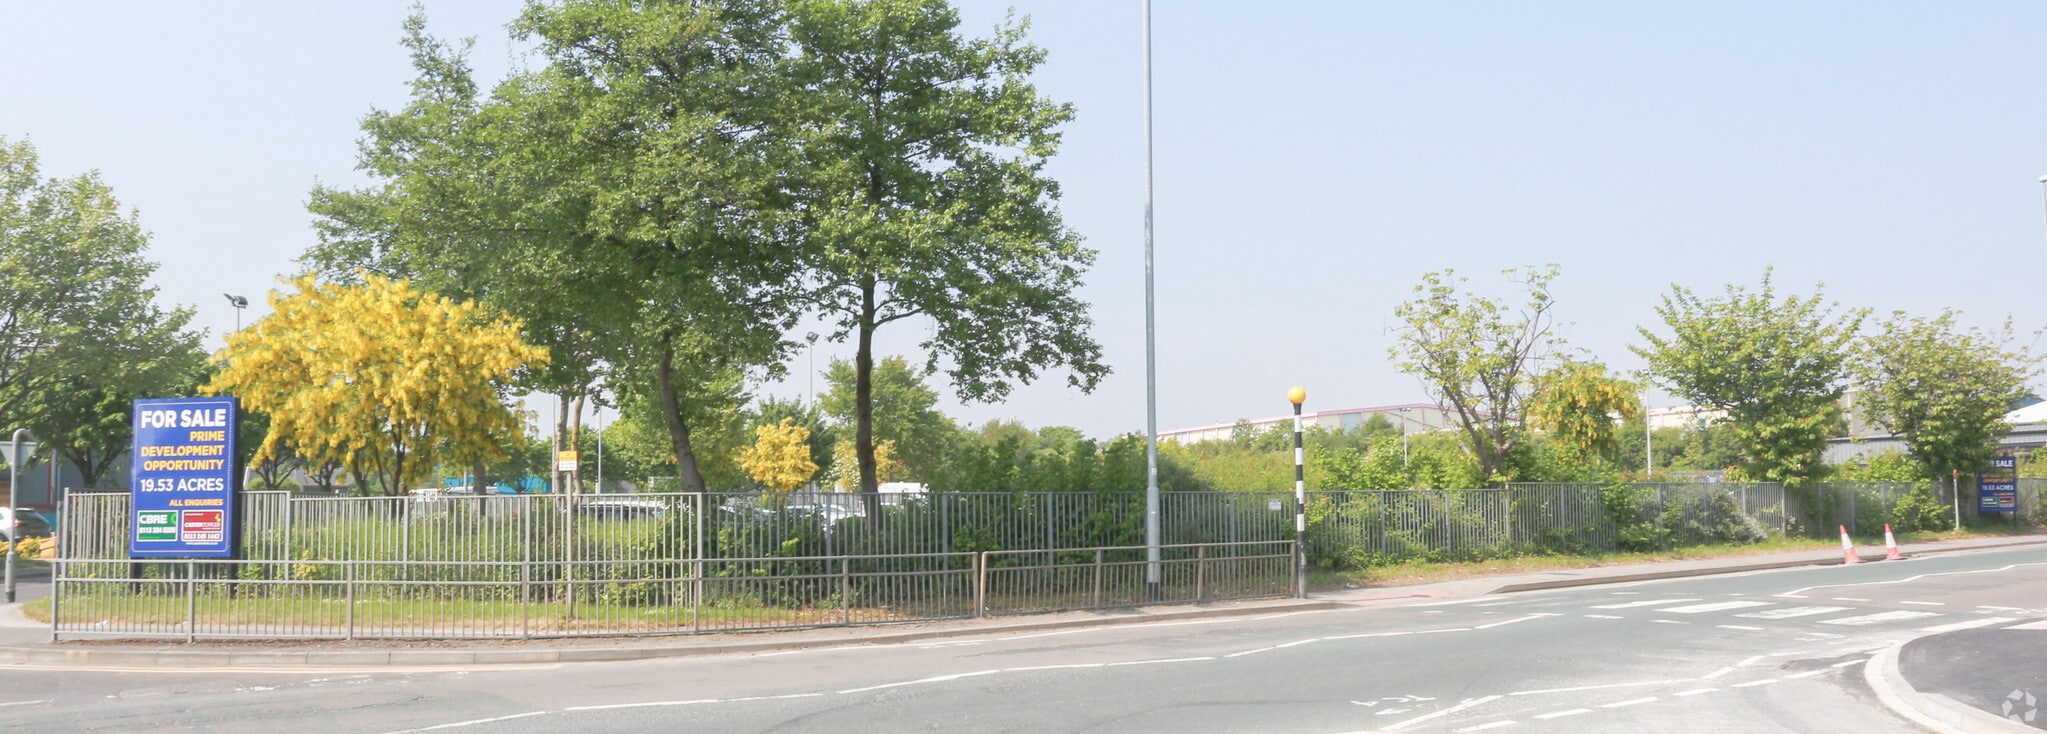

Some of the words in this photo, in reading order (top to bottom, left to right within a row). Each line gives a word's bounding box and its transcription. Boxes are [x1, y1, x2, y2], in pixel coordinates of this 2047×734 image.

[141, 410, 177, 428] FOR
[180, 408, 226, 427] SALE
[190, 430, 225, 442] PRIME
[141, 445, 225, 457] DEVELOPMENT
[143, 459, 224, 471] OPPORTUNITY
[1995, 459, 2013, 467] SALE
[140, 478, 174, 492] 19.53
[176, 478, 224, 491] ACRES
[184, 498, 224, 506] ENQUIRIES
[139, 514, 168, 524] CBRE
